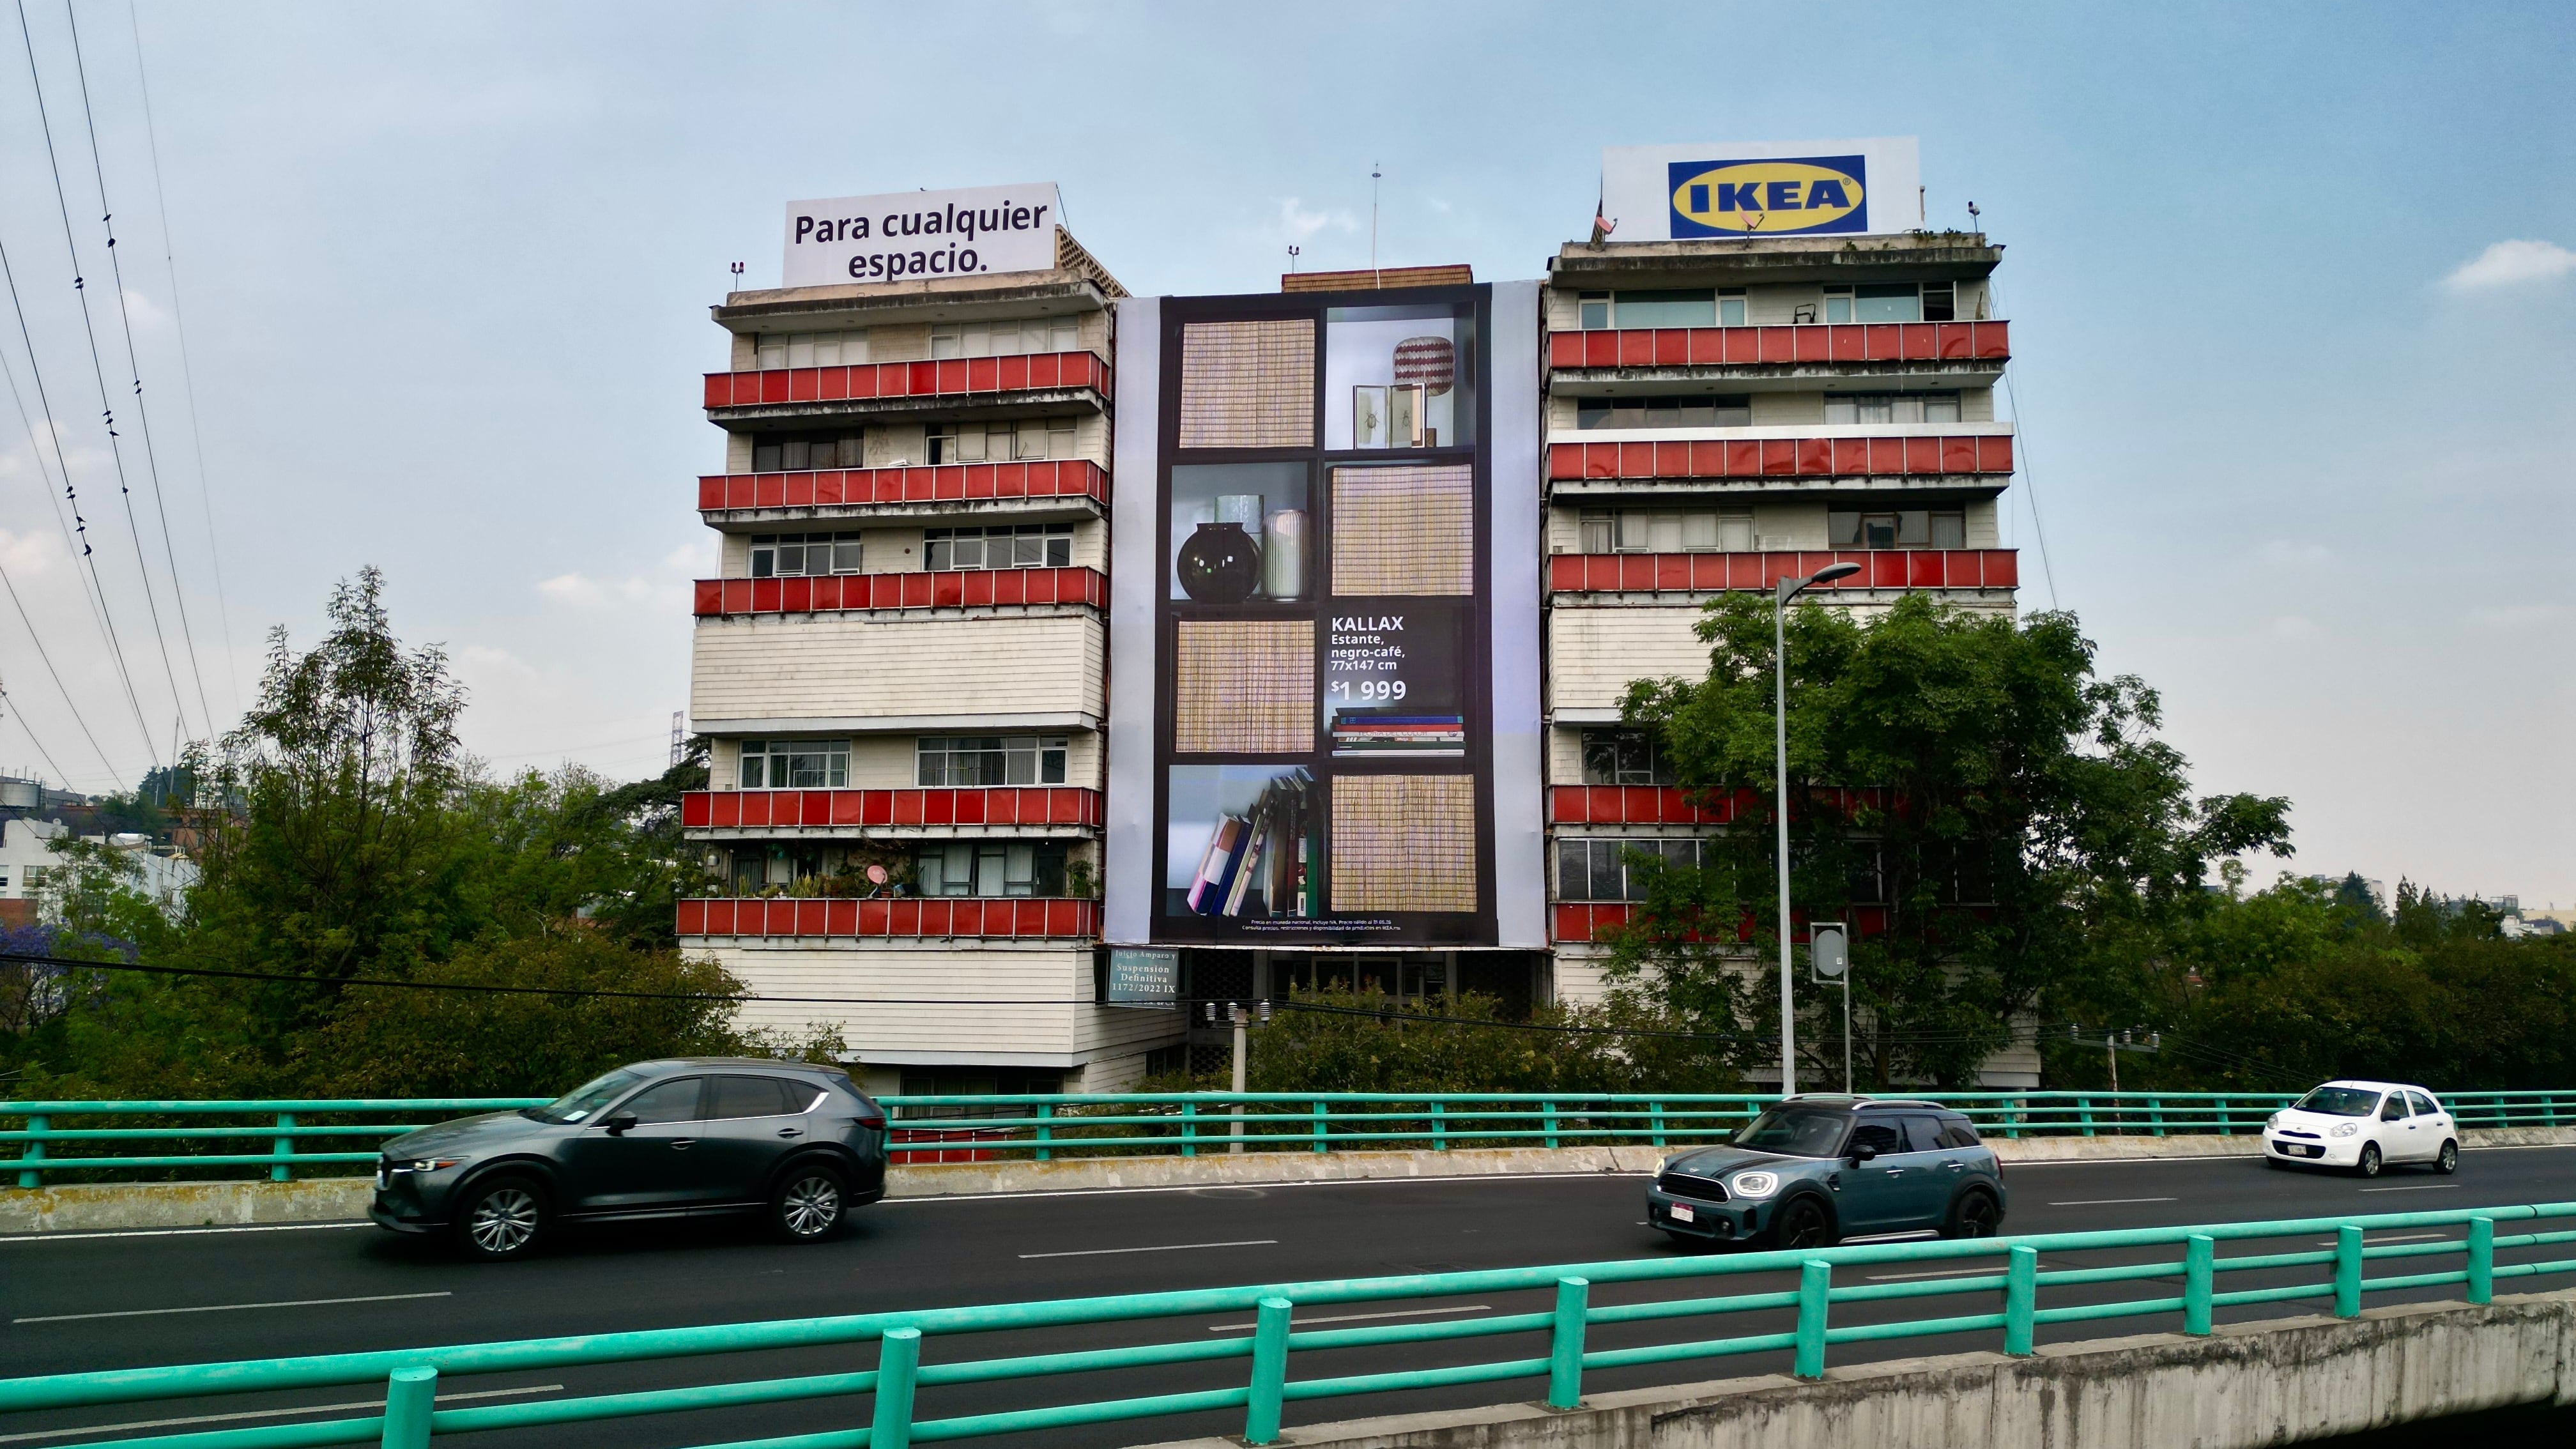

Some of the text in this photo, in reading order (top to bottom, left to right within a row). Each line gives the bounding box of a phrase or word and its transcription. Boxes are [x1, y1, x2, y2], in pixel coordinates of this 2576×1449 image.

[1690, 179, 1851, 213] IKEA
[795, 199, 1048, 244] Para cualquier
[848, 242, 988, 281] espacio.
[1331, 616, 1404, 632] KALLAX
[1331, 634, 1385, 645] Estante,
[1331, 645, 1406, 661] negro-café,
[1330, 659, 1397, 671] 77x147 cm
[1140, 951, 1169, 959] Amparo
[1121, 973, 1167, 983] Definitiva
[1112, 983, 1160, 992] 1172/2022
